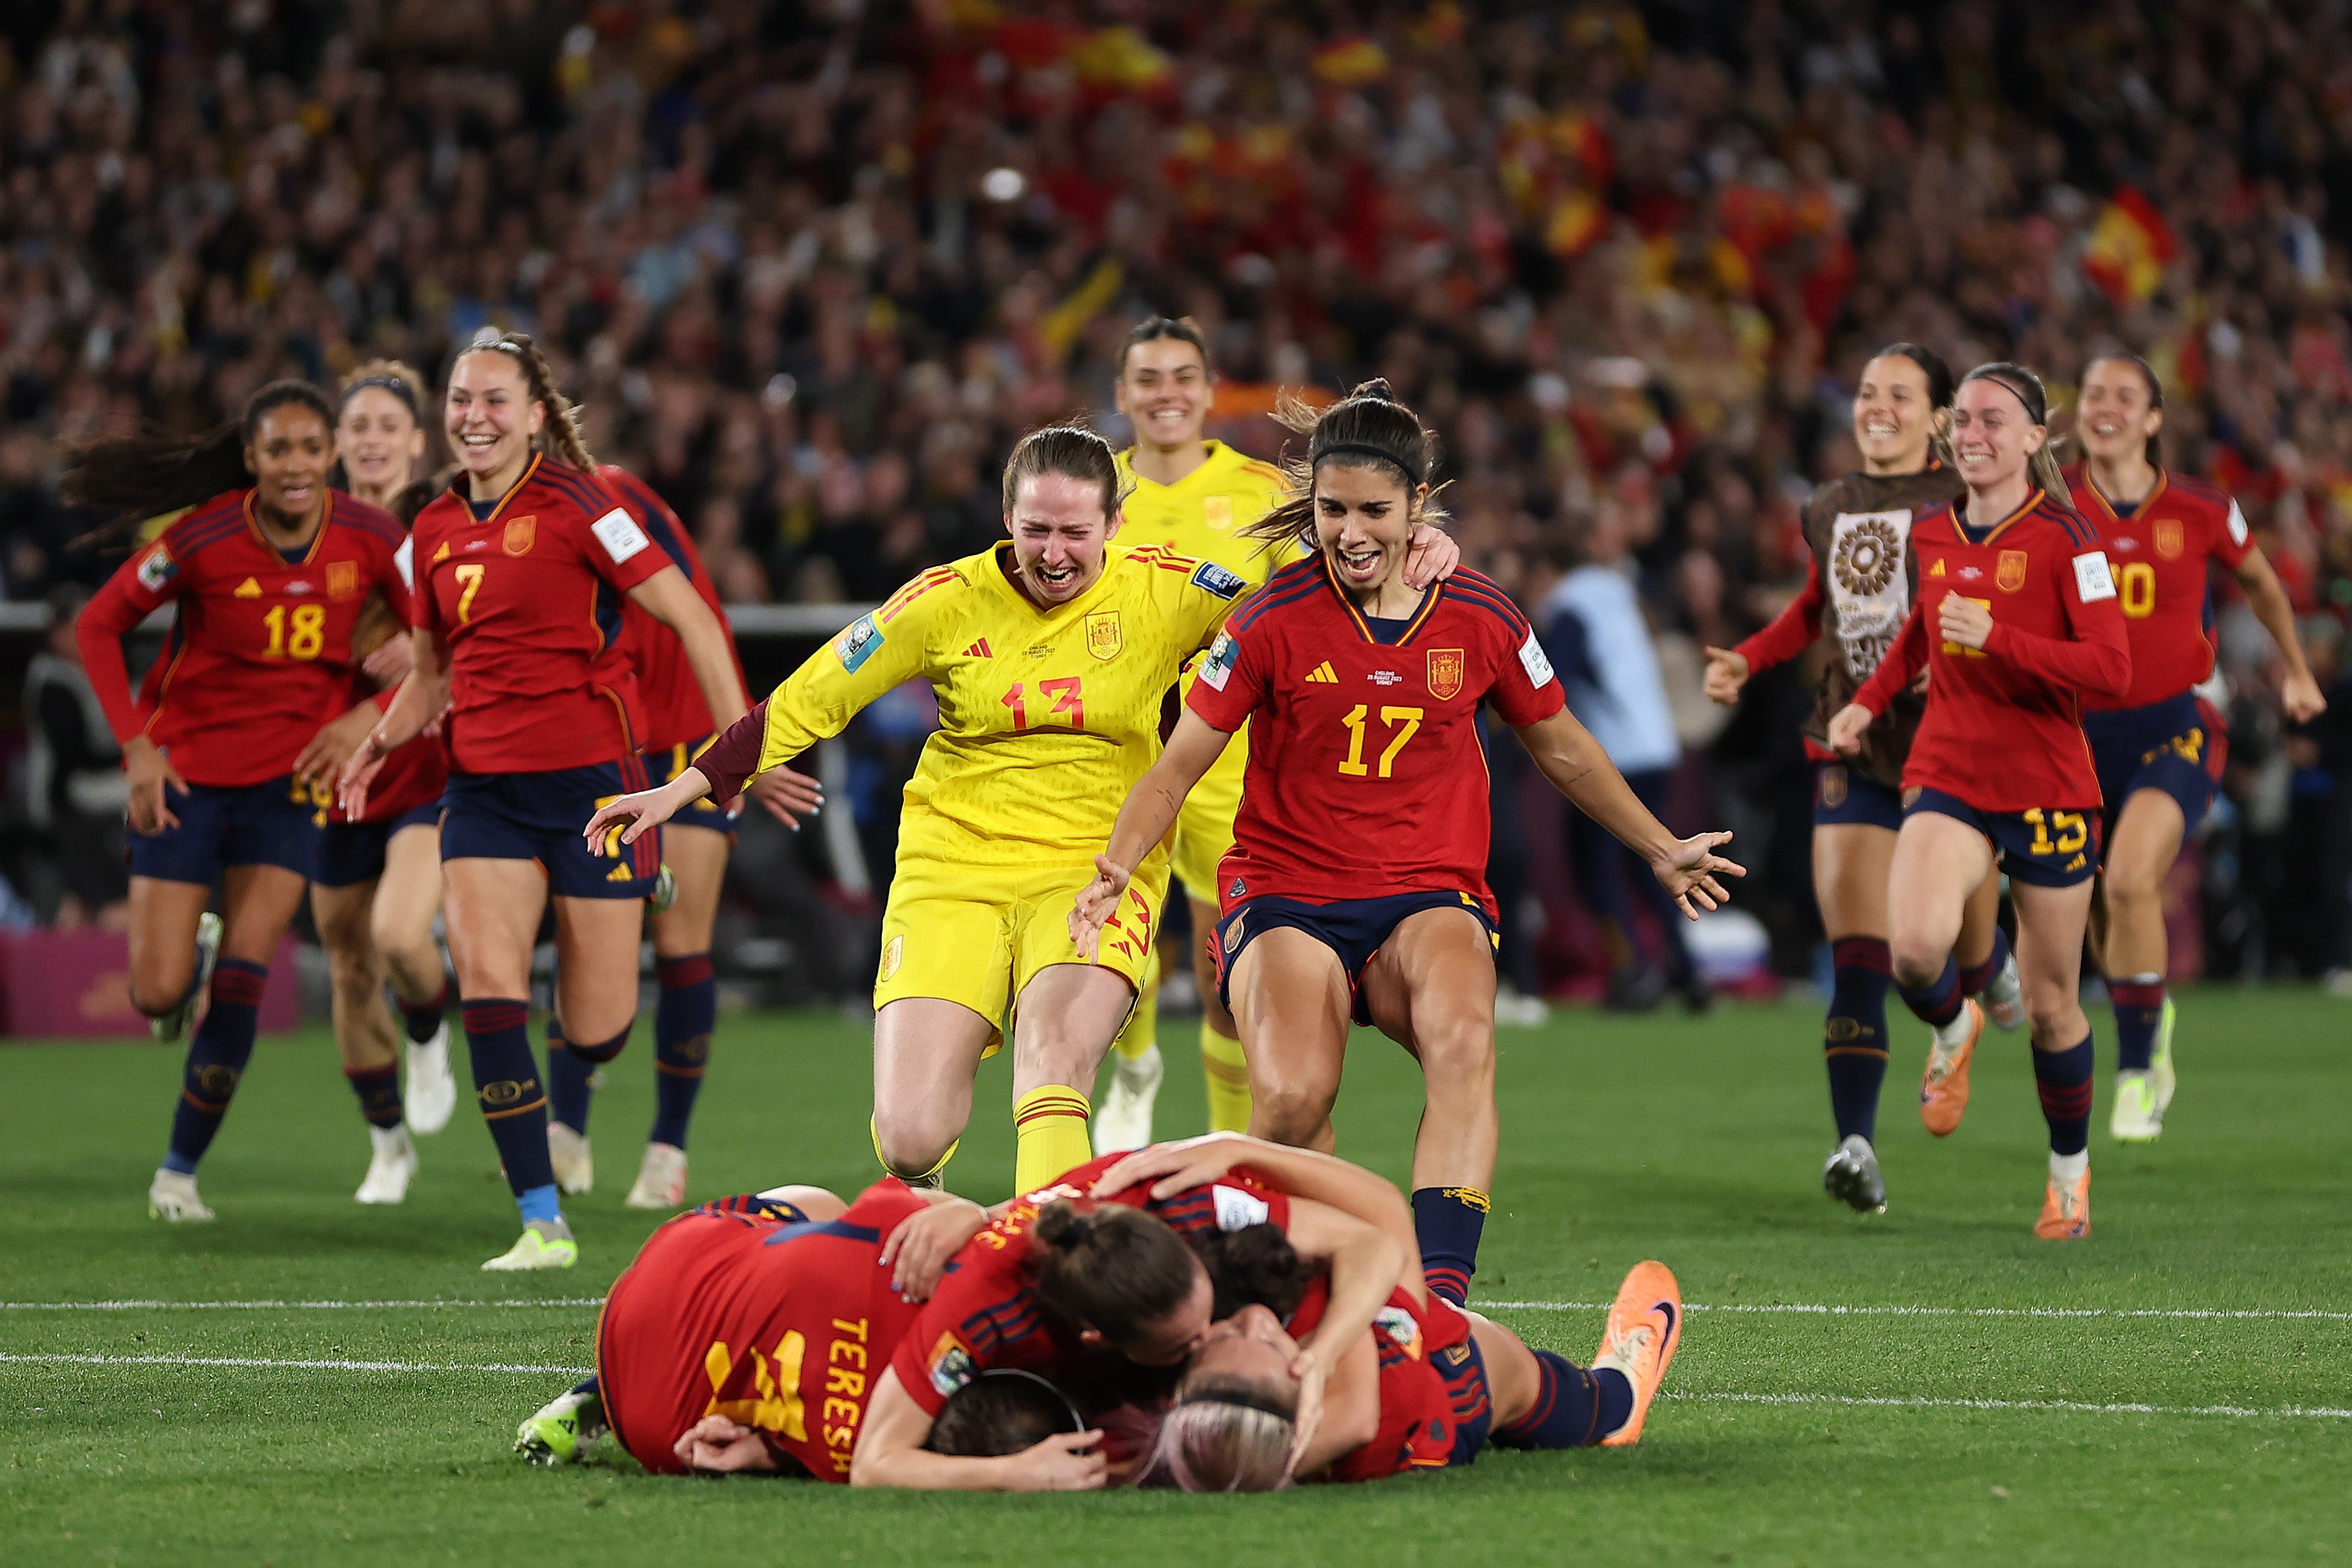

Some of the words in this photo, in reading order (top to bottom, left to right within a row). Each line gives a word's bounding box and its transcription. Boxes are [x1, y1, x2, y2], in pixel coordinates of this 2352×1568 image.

[454, 563, 486, 625] 7
[262, 603, 326, 659] 18
[1001, 677, 1084, 731] 13
[1338, 704, 1424, 778] 17
[2022, 807, 2087, 855] 15
